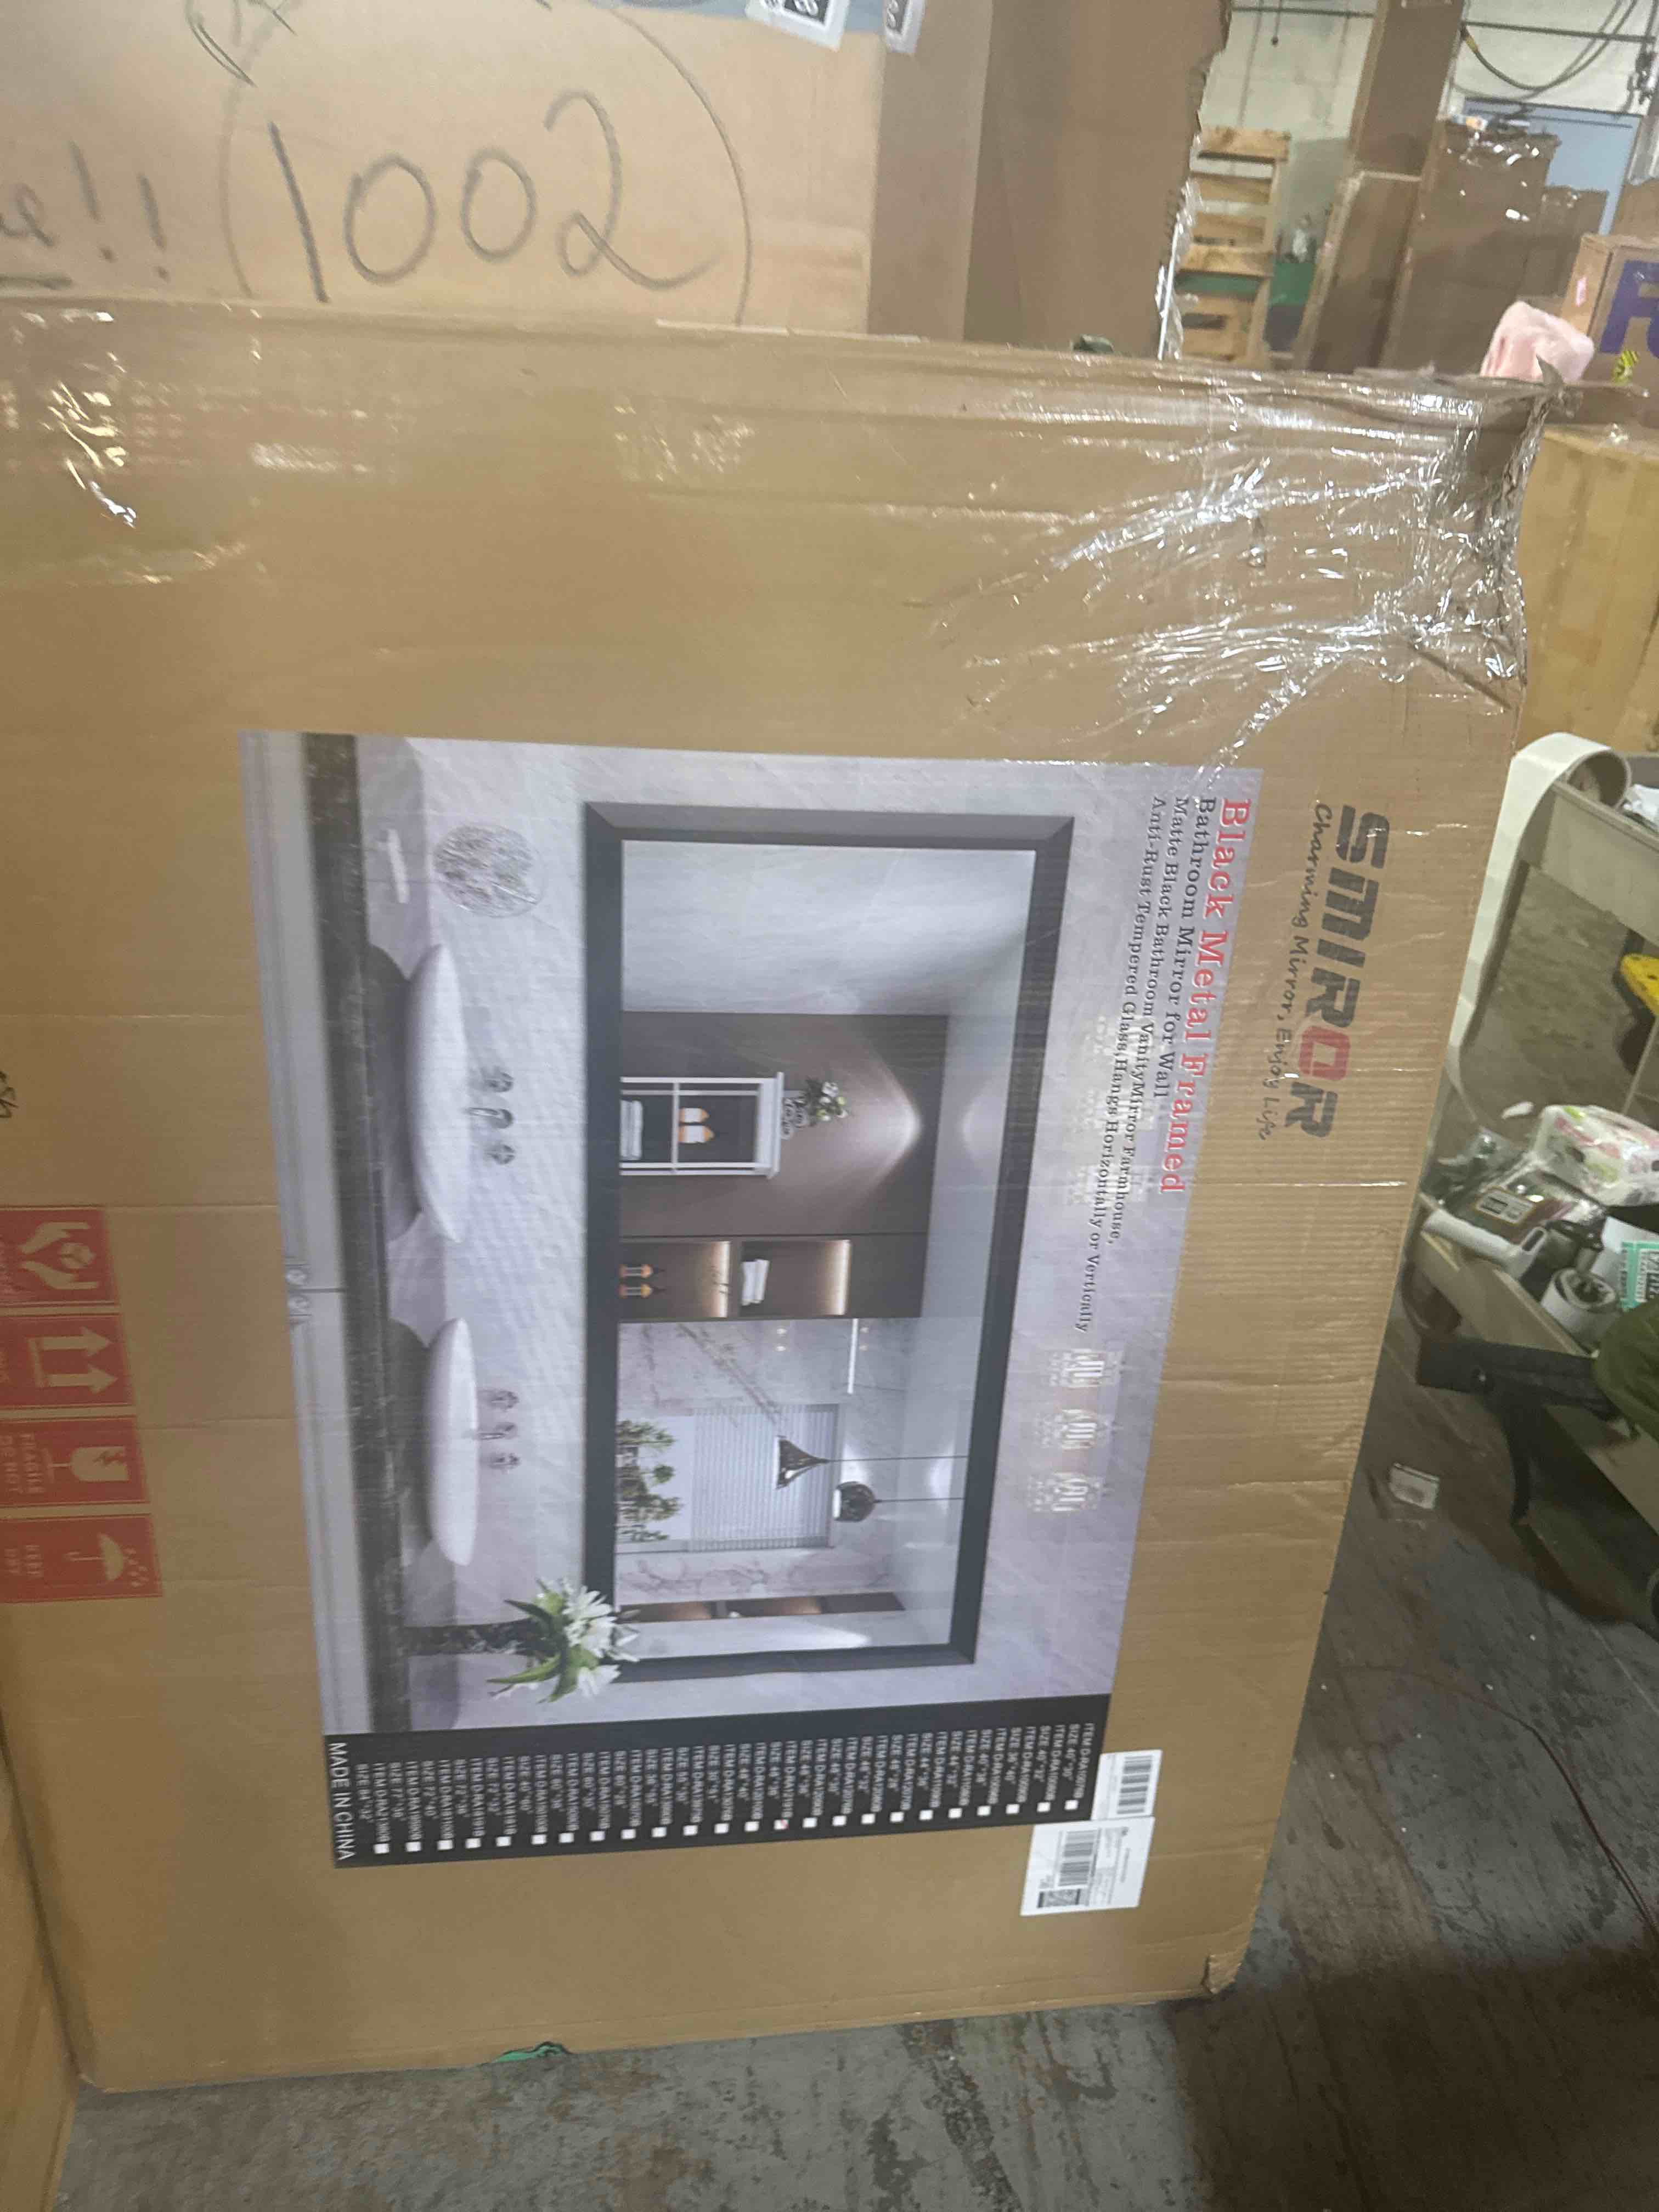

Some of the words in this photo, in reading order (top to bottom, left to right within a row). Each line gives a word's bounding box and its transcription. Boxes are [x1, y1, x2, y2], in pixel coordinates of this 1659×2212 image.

[268, 88, 725, 303] 1002
[1139, 797, 1166, 896] Anti-Rust
[1167, 797, 1189, 856] Matte
[1181, 797, 1217, 919] Bathroom
[1203, 798, 1252, 919] Black
[1293, 803, 1333, 928] Charming
[1158, 862, 1179, 918] Black
[1124, 901, 1151, 996] Tempered
[1143, 923, 1169, 1016] Bathroom
[1168, 926, 1195, 1006] Mirror
[1183, 930, 1229, 1042] Metal
[1277, 935, 1310, 1021] Mirror,
[1161, 1012, 1181, 1045] for
[1262, 1028, 1294, 1089] Enjoy
[1154, 1052, 1175, 1098] Wall
[1159, 1052, 1209, 1194] Framed
[1256, 1096, 1282, 1141] Life
[1089, 1119, 1119, 1228] Horizontally
[1108, 1146, 1136, 1245] Farmhouse,
[1089, 1233, 1102, 1251] or
[1074, 1255, 1101, 1334] Vertically
[328, 1742, 350, 1789] MADE
[332, 1791, 353, 1808] IN
[334, 1812, 356, 1861] CHINA
